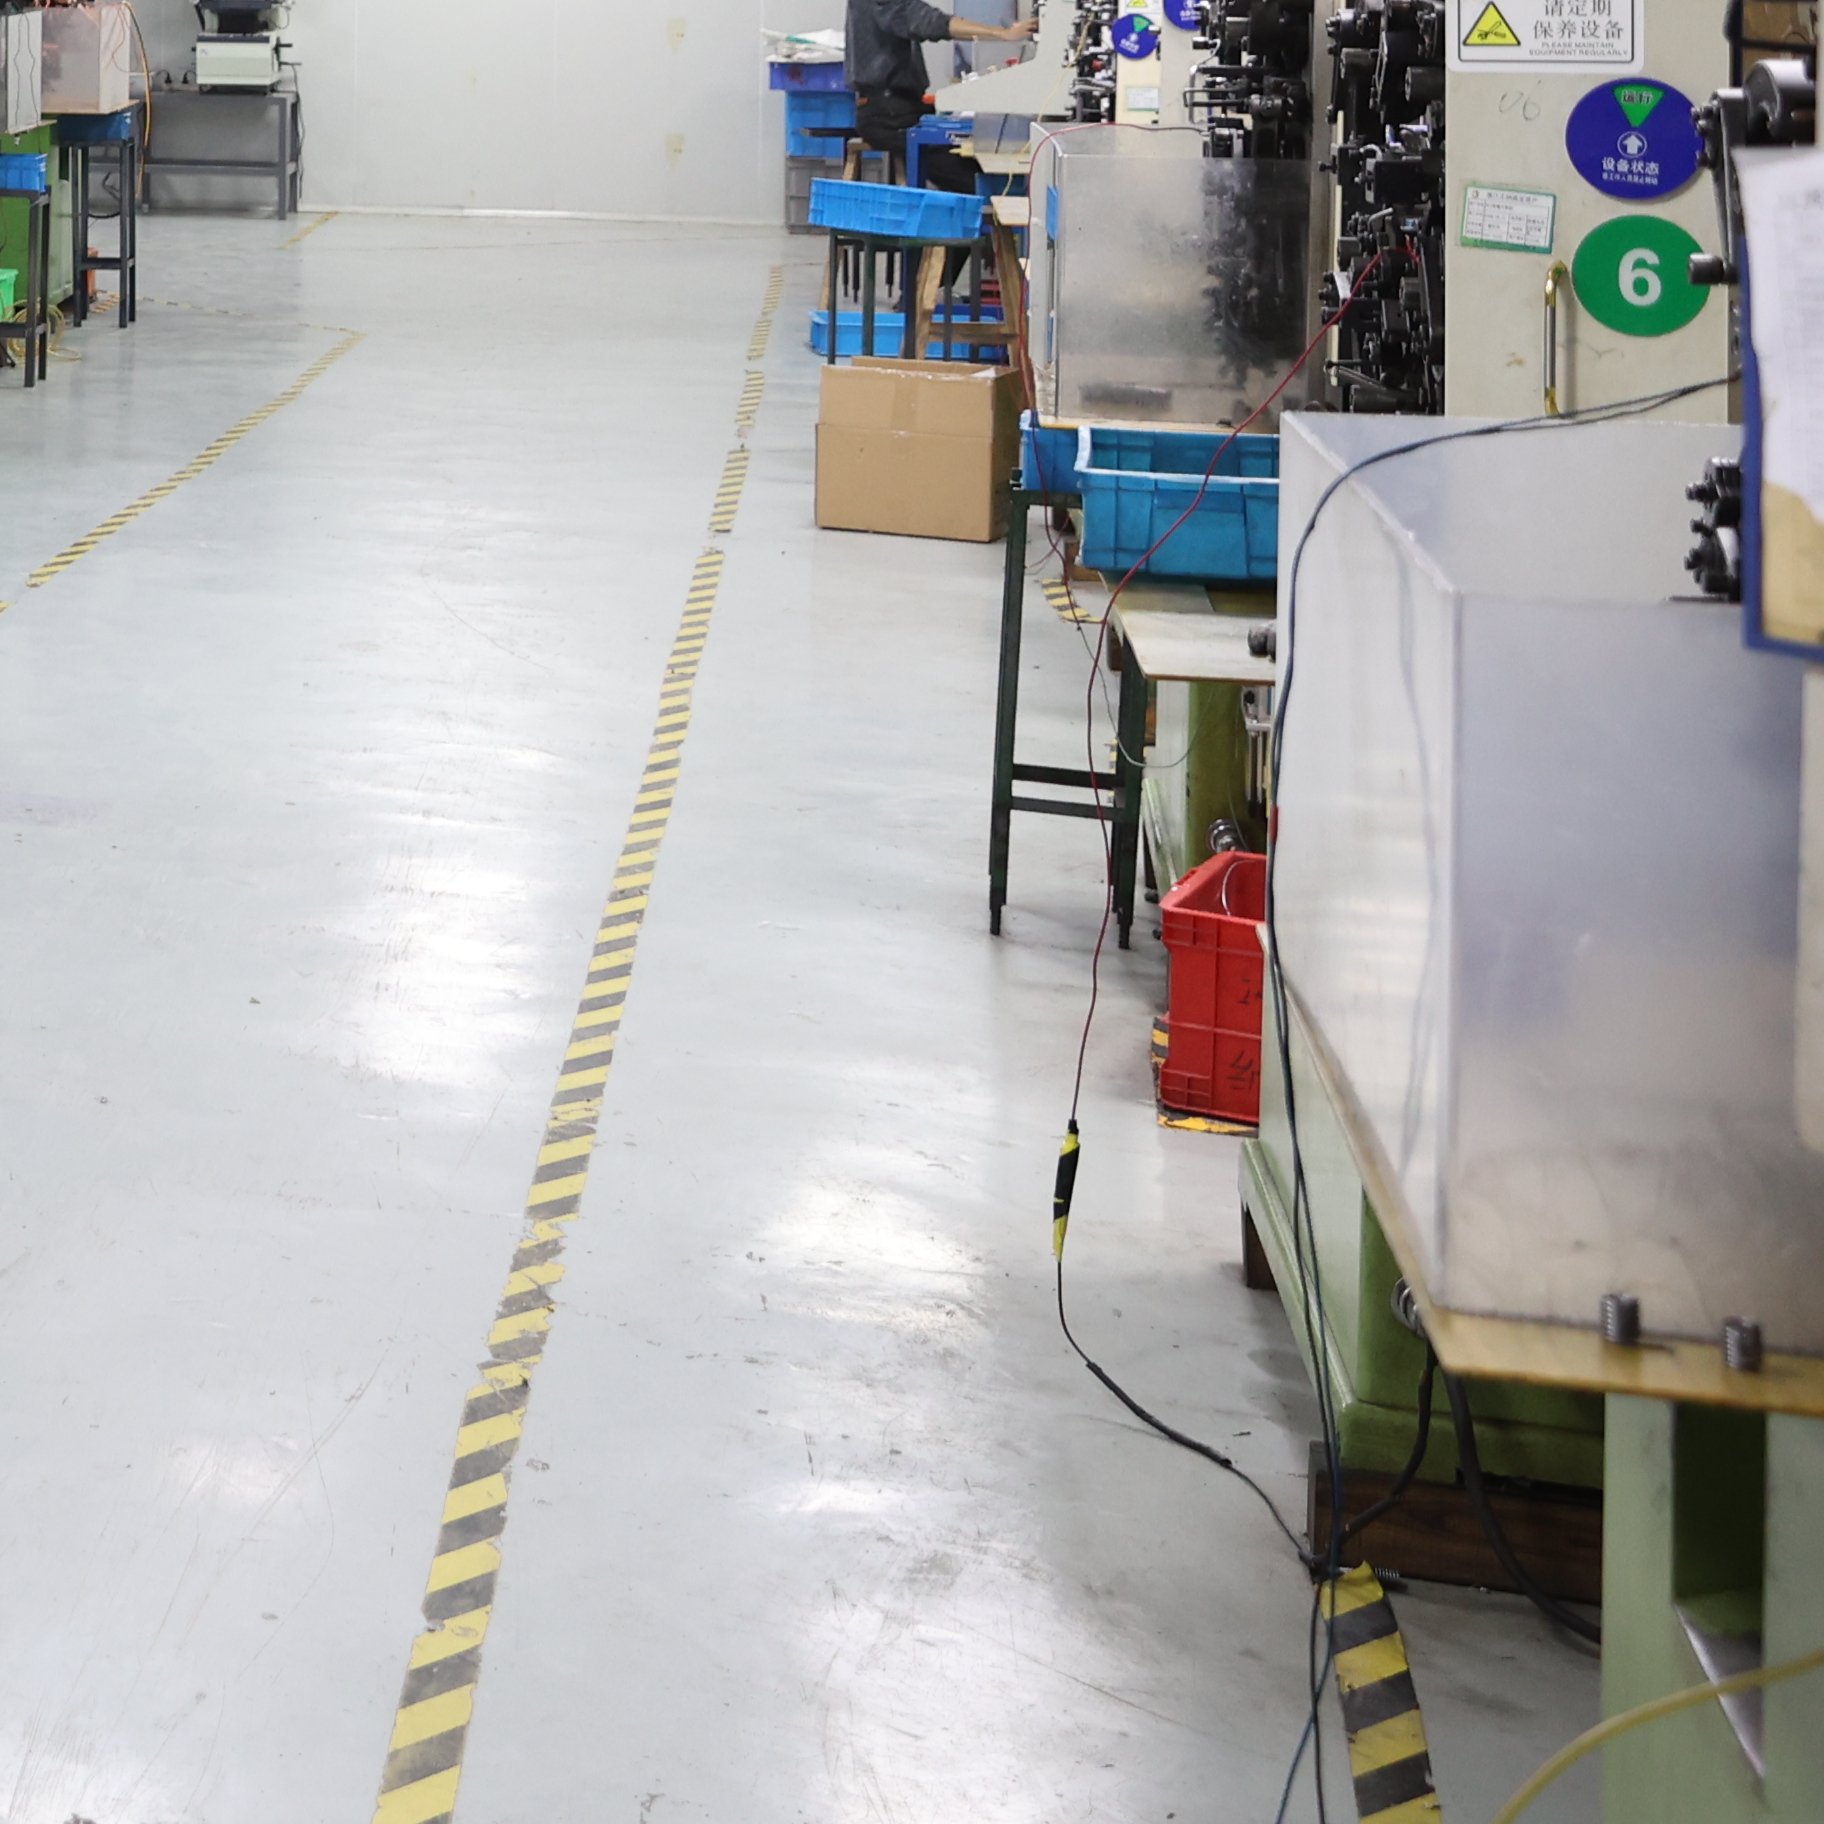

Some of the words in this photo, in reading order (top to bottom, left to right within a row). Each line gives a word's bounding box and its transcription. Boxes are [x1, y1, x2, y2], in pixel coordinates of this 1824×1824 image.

[1533, 20, 1624, 40] 保养设备
[1622, 90, 1653, 105] 运行
[1602, 156, 1660, 175] 设备状态
[1617, 249, 1662, 307] 6
